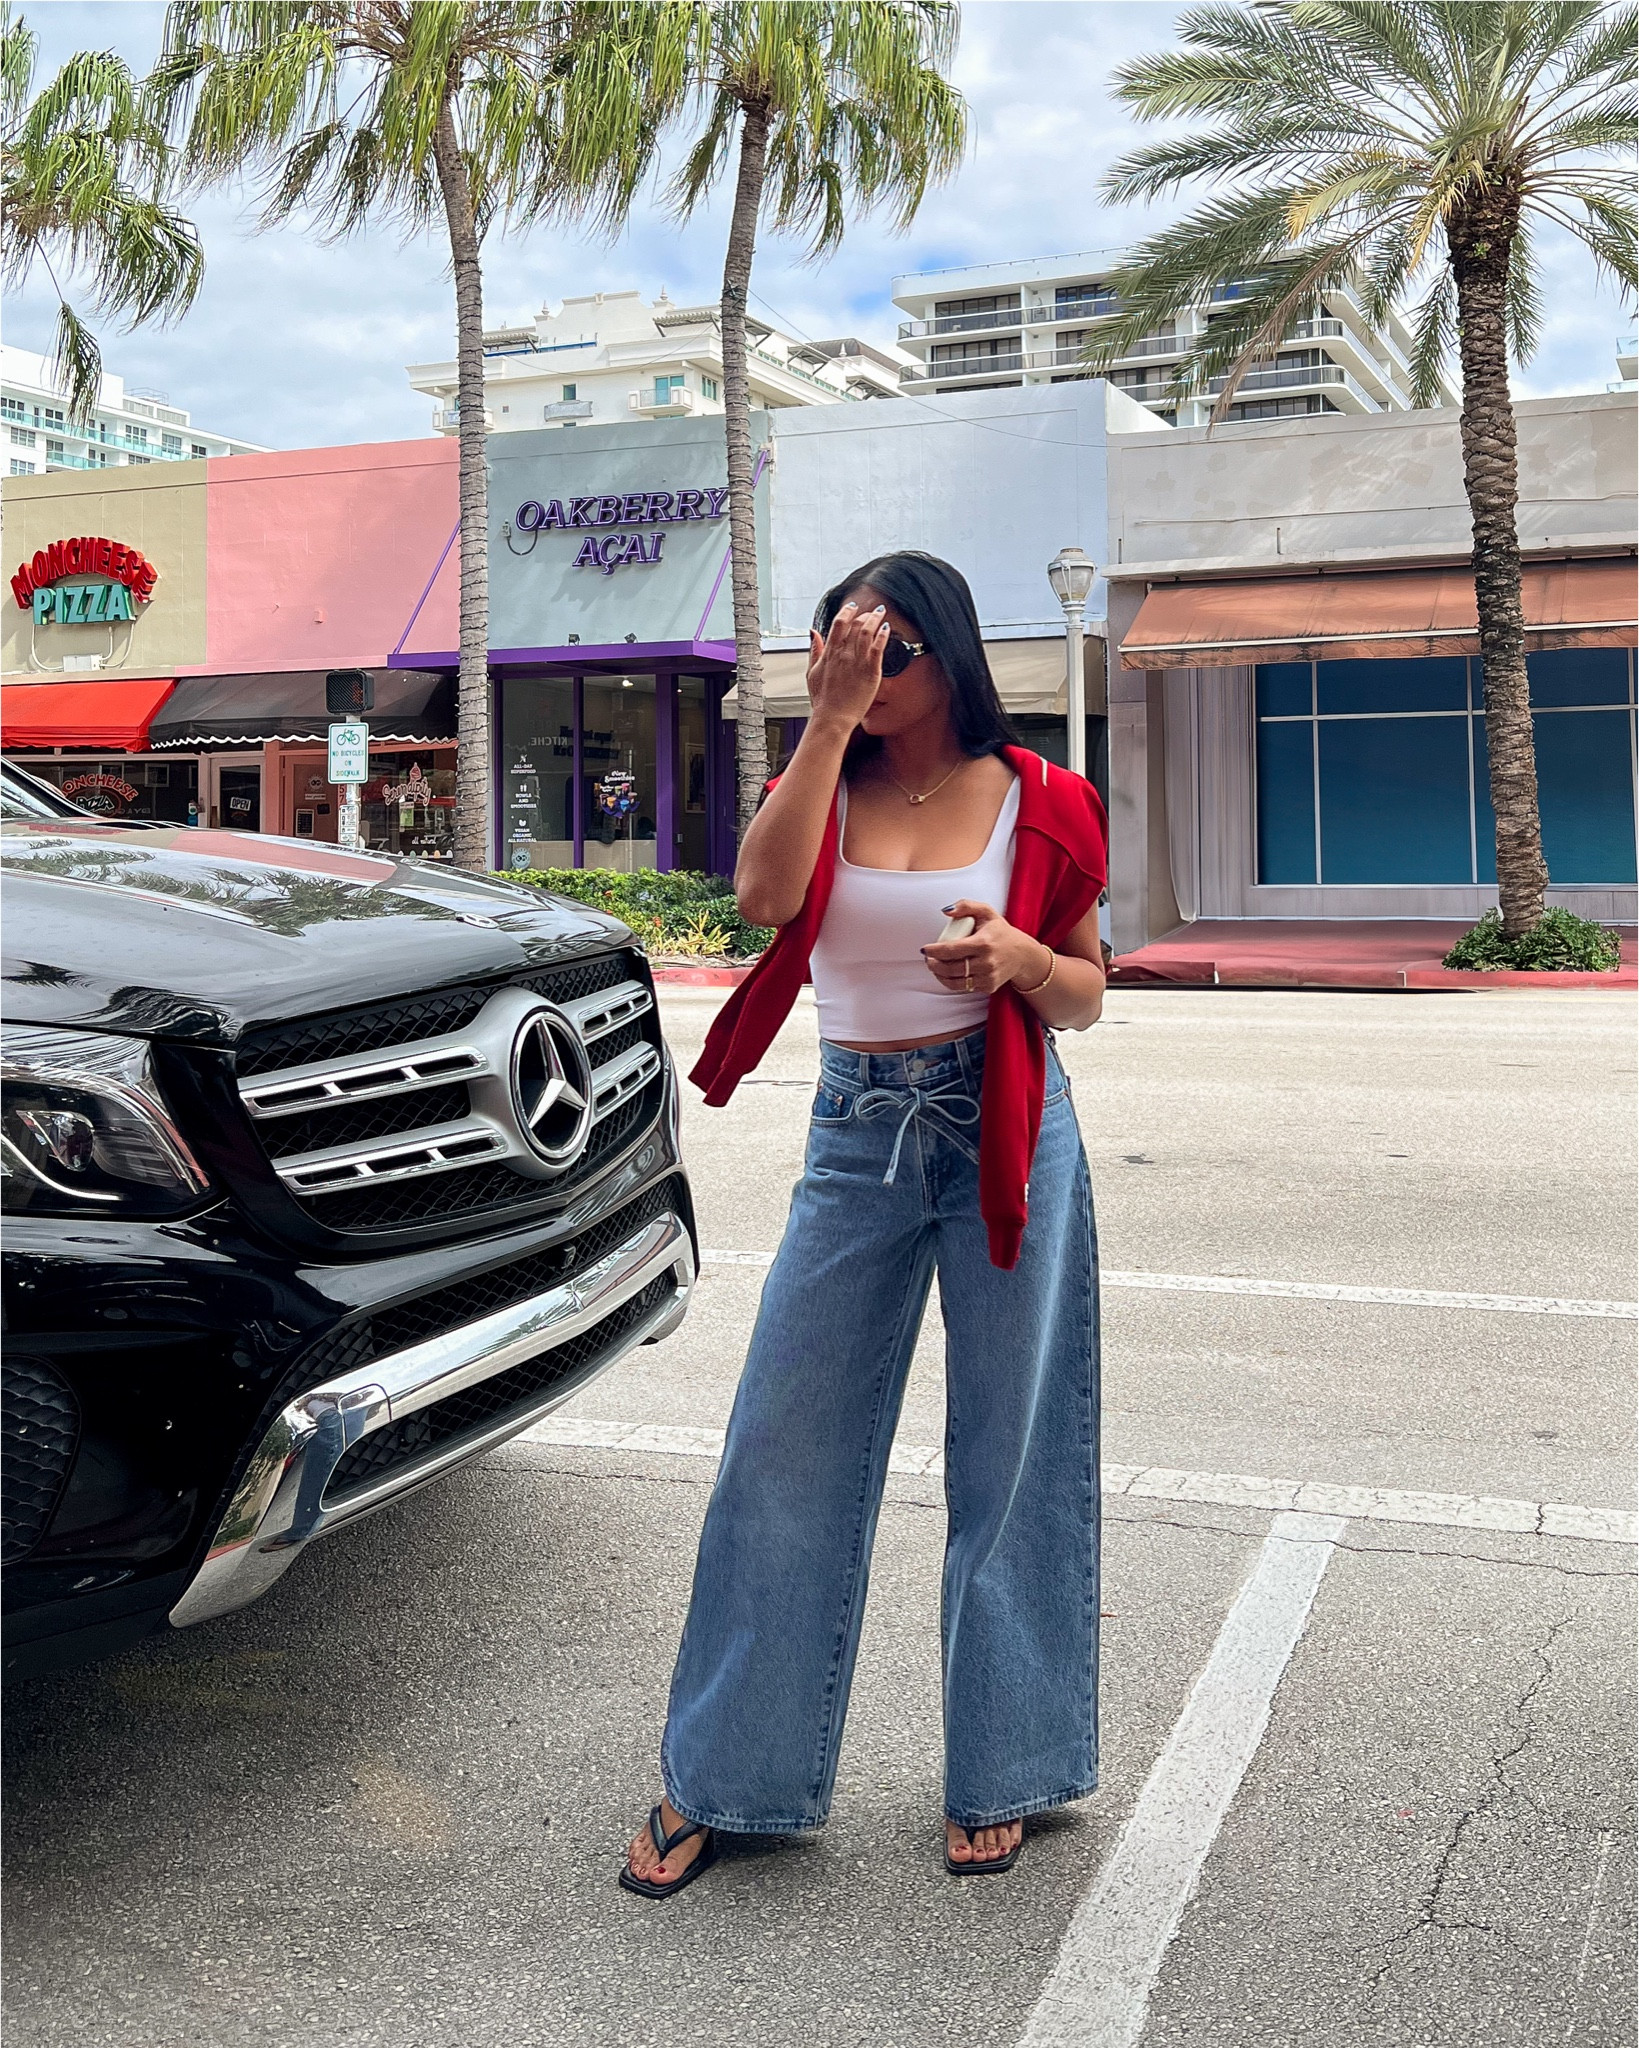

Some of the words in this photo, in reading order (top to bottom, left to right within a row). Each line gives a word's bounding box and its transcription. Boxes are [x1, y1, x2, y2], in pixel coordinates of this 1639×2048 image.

[516, 487, 729, 531] OAKBERRY
[10, 537, 158, 609] MONCHEESE
[572, 532, 665, 575] AÇAI
[33, 584, 136, 625] PIZZA
[61, 773, 139, 802] ONCHEESE
[231, 798, 249, 810] OPEN
